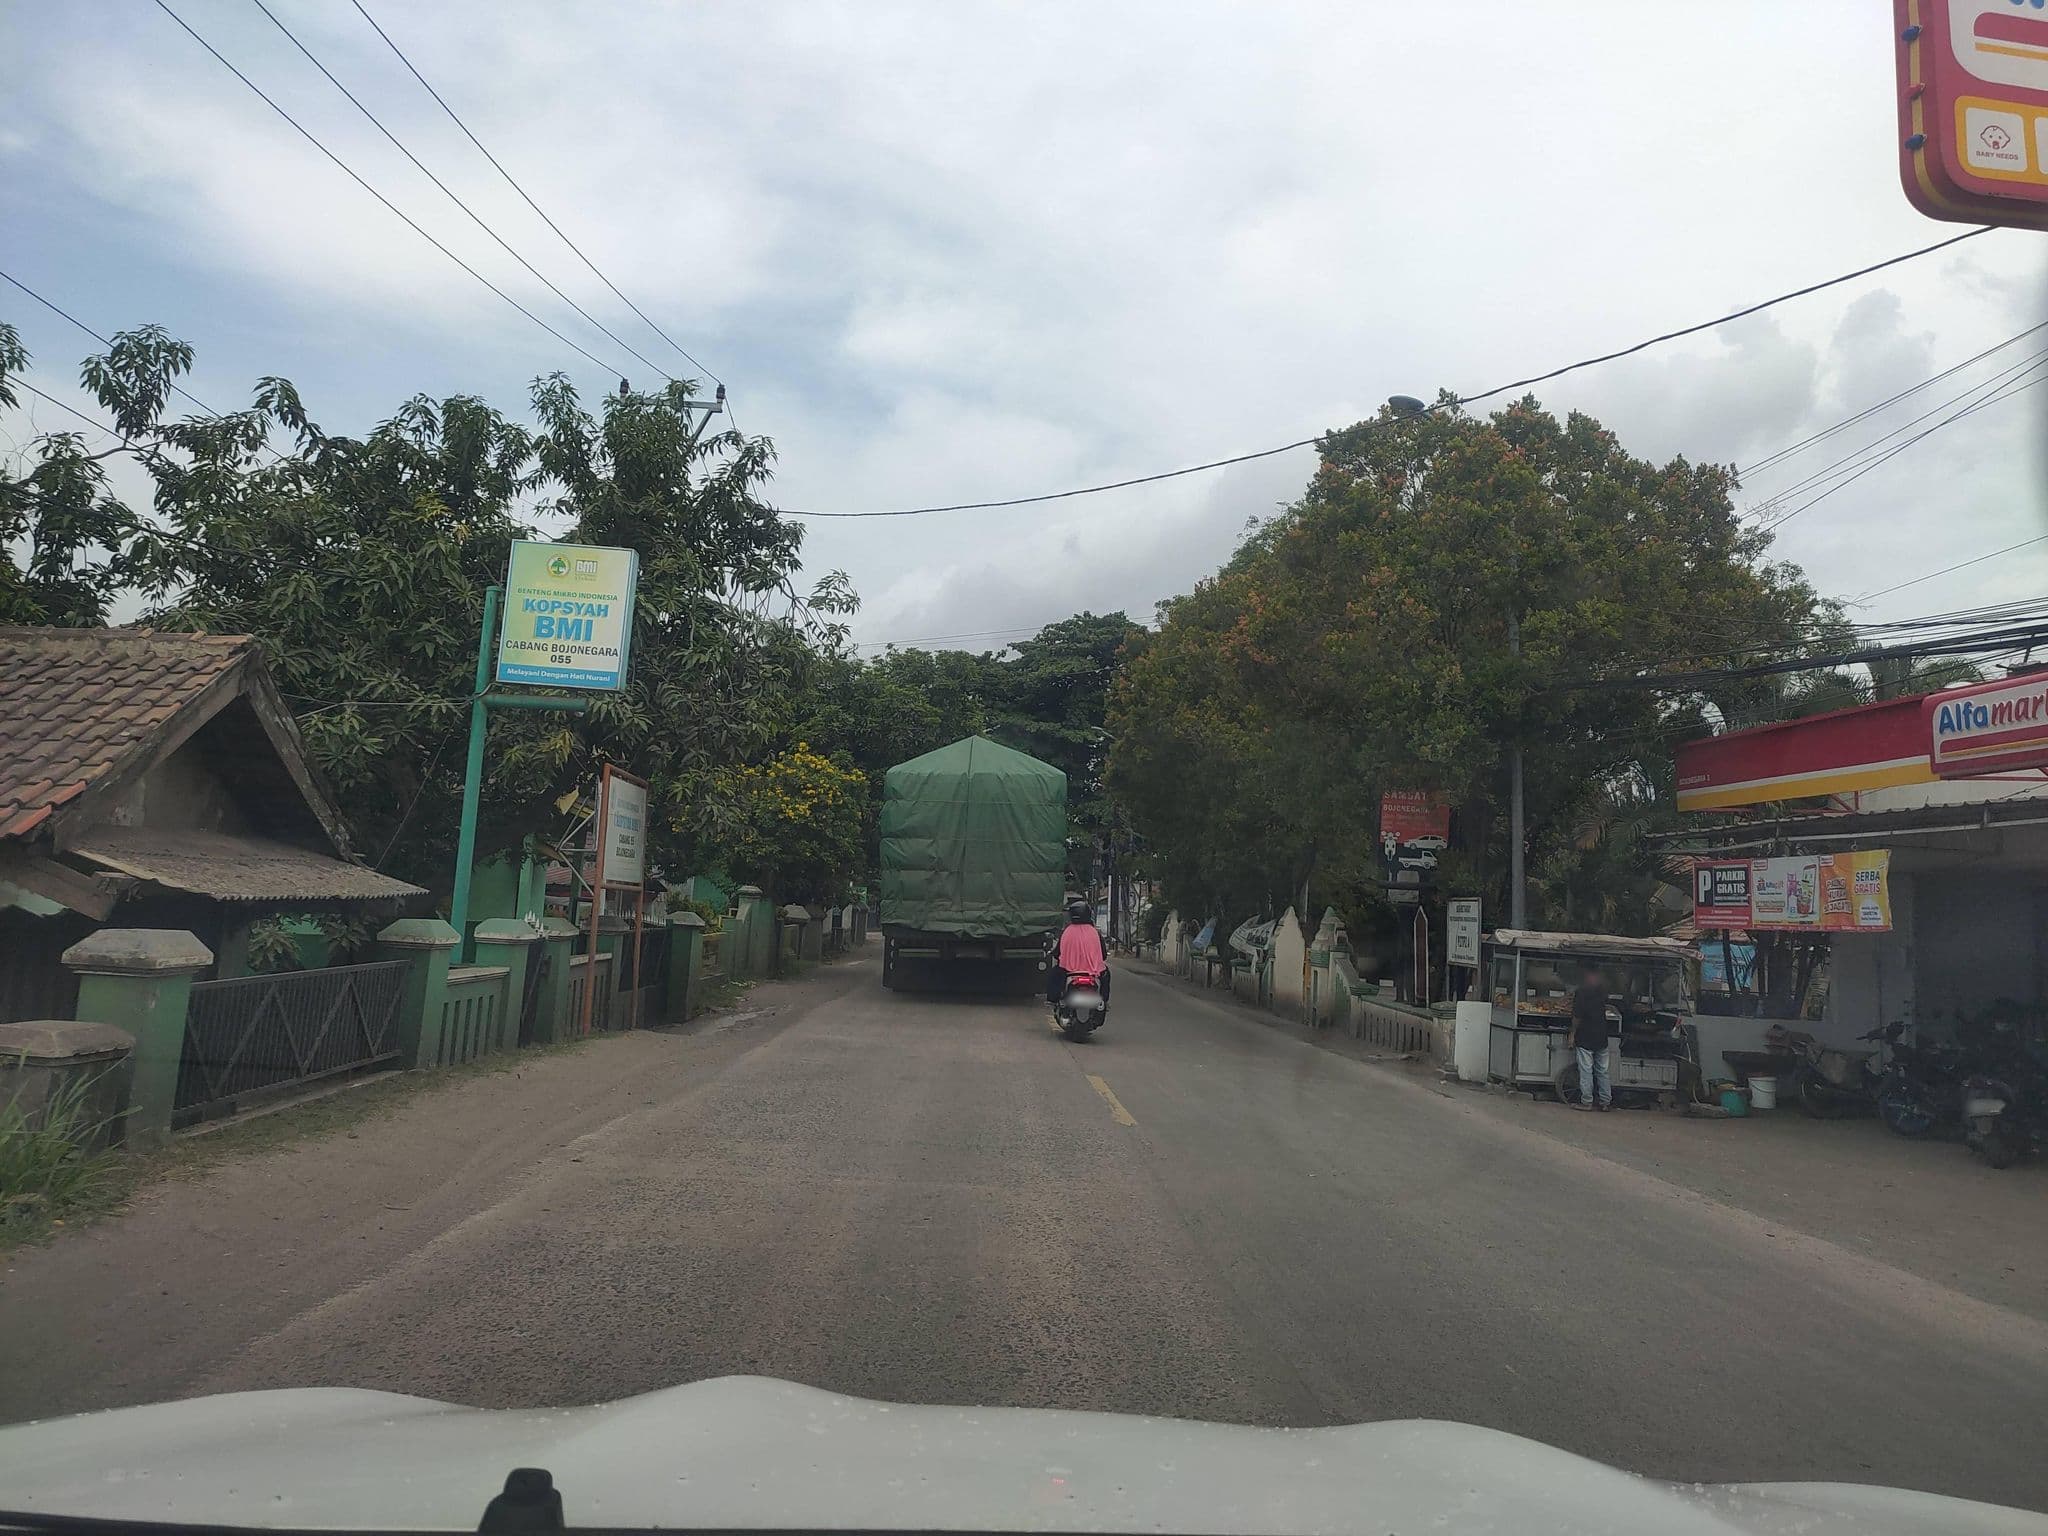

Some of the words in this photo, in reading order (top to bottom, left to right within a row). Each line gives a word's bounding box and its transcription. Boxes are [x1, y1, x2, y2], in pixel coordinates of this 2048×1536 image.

[1975, 150, 1994, 158] BABY
[1995, 152, 2019, 161] NEEDS
[517, 587, 551, 597] BENTENG
[553, 590, 577, 598] MIKRO
[578, 592, 618, 601] INDONESIA
[523, 598, 609, 618] KOPSYAH
[534, 615, 594, 642] BMI
[505, 639, 549, 652] CABANG
[551, 644, 619, 657] BOJONEGARA
[550, 654, 572, 665] 055
[506, 668, 540, 677] Melayani
[541, 671, 569, 679] Dengan
[585, 674, 611, 682] Nurani
[1939, 688, 2048, 735] Alfamar
[1716, 870, 1746, 881] PARKIR
[1855, 870, 1880, 882] SERBA
[1698, 870, 1712, 902] P
[1717, 883, 1746, 894] GRATIS
[1855, 883, 1881, 894] GRATIS
